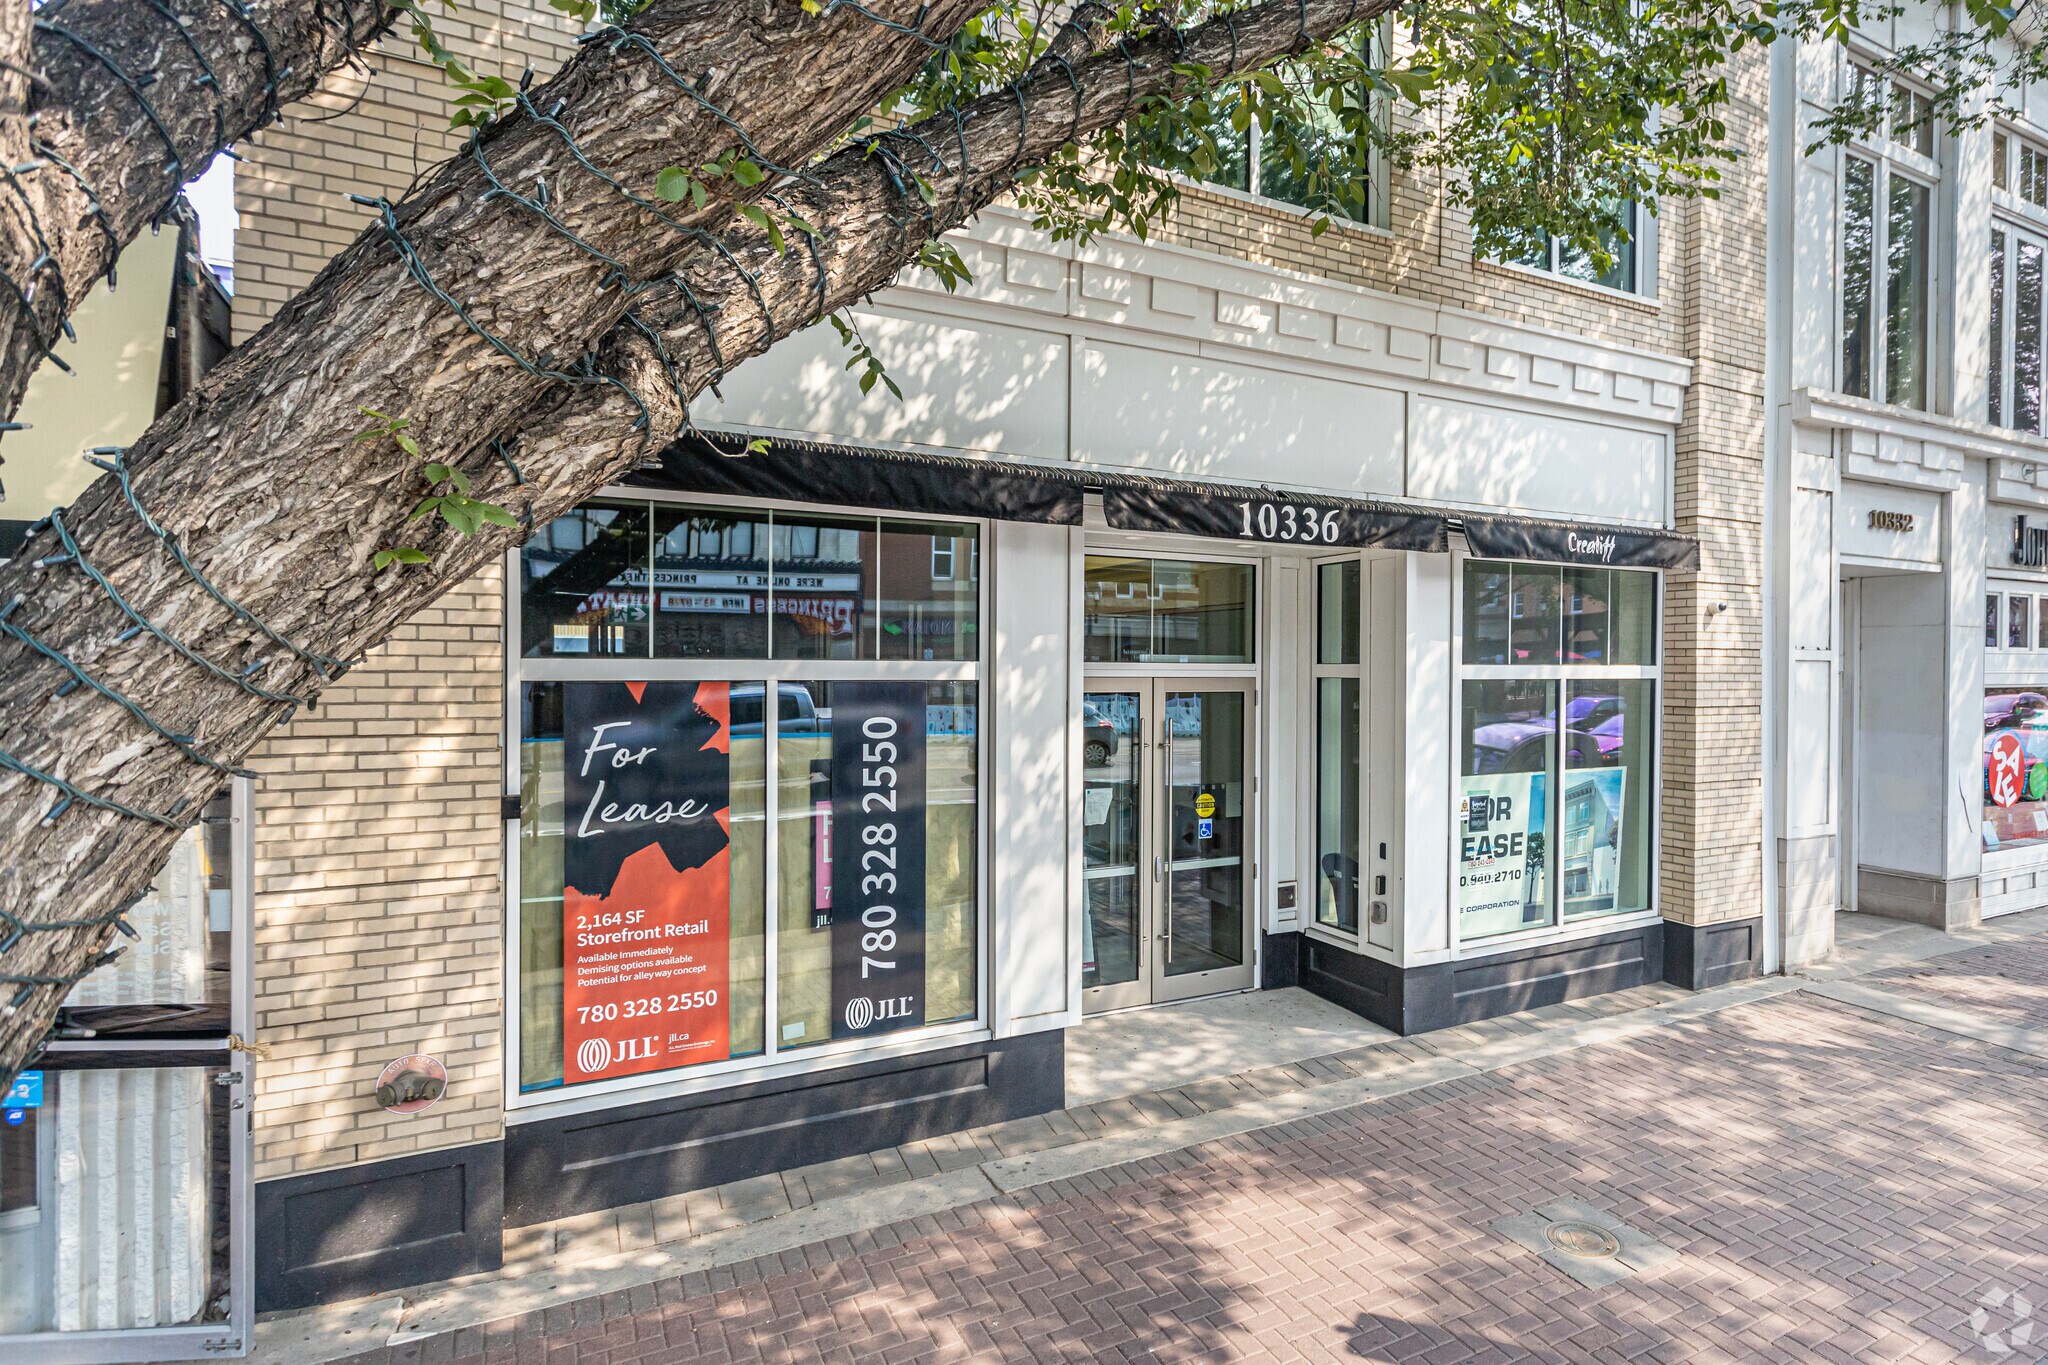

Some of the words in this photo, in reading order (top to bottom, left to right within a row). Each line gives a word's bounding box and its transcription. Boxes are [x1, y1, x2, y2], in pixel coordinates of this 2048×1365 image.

[1239, 501, 1341, 544] 10336
[1868, 509, 1914, 532] 10332
[2010, 514, 2048, 567] JOH
[580, 720, 658, 778] For
[861, 716, 897, 813] 2550
[577, 780, 709, 838] Lease
[861, 822, 897, 896] 328
[1466, 899, 1520, 913] CORPORATION
[576, 912, 622, 931] 2,164
[625, 909, 646, 924] SF
[576, 926, 662, 947] Storefront
[664, 920, 709, 937] Retail
[577, 951, 618, 964] Available
[619, 945, 674, 960] Immediately
[861, 905, 897, 979] 780
[577, 963, 620, 976] Demising
[621, 959, 654, 972] options
[655, 954, 693, 967] available
[577, 974, 618, 987] Potential
[619, 971, 633, 983] for
[673, 964, 707, 976] concept
[576, 1003, 618, 1025] 780
[622, 997, 662, 1018] 328
[666, 989, 718, 1012] 2550
[874, 996, 913, 1021] JLL
[613, 1036, 659, 1063] JLL
[668, 1032, 690, 1044] jll.ca
